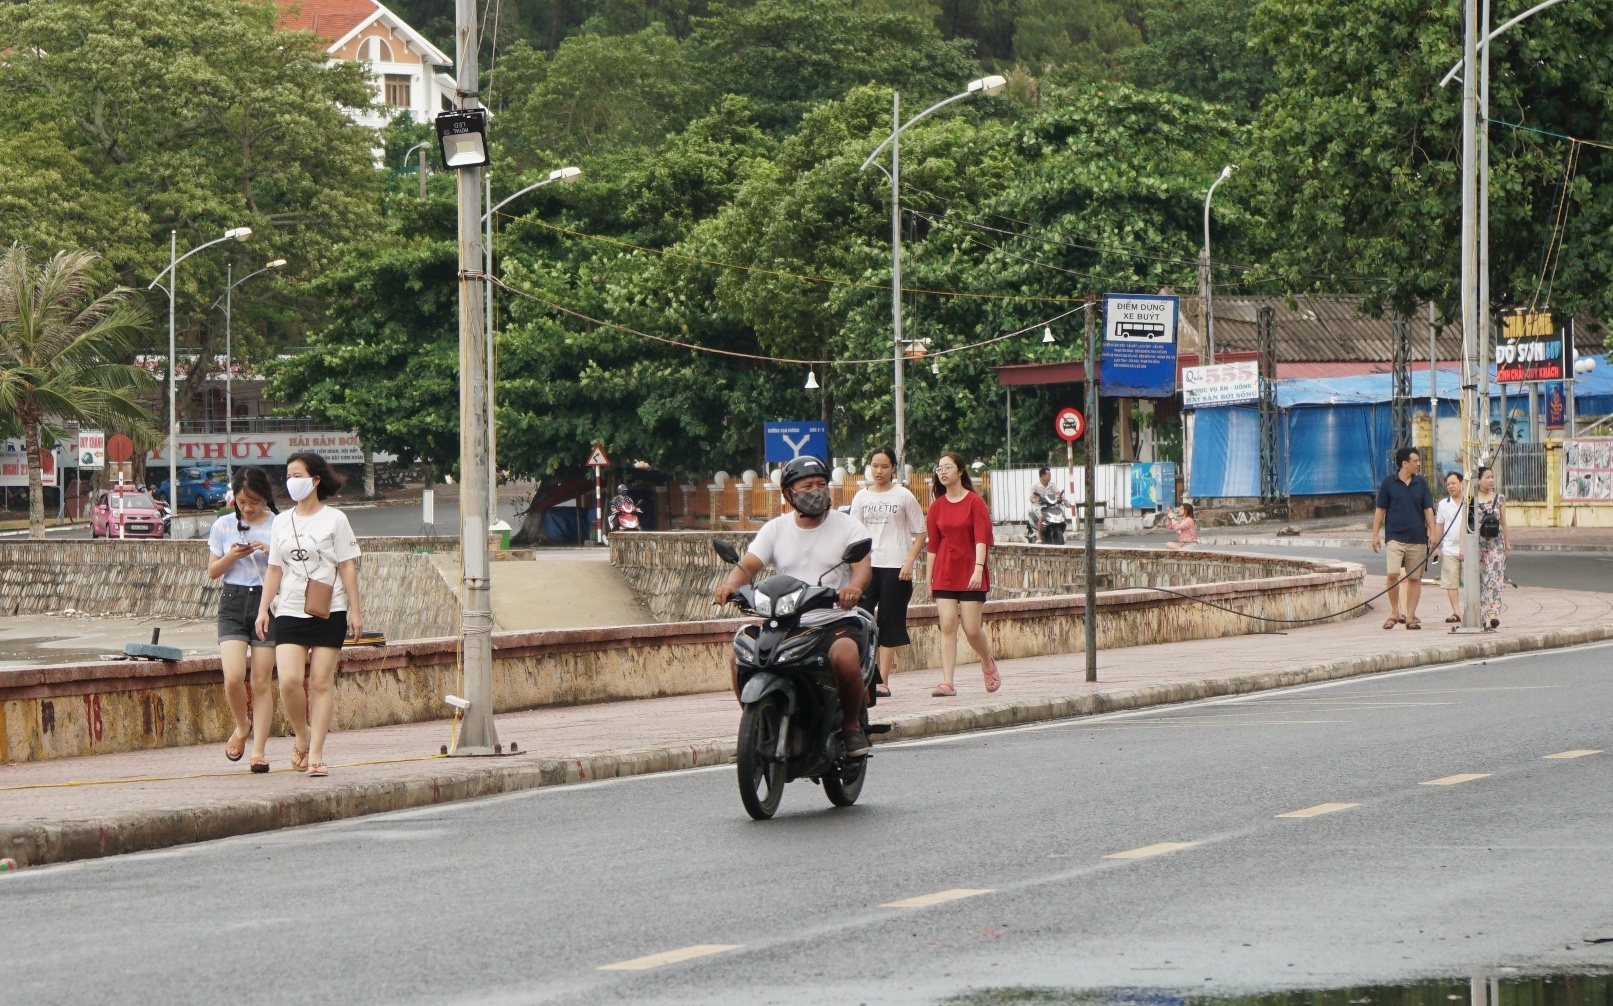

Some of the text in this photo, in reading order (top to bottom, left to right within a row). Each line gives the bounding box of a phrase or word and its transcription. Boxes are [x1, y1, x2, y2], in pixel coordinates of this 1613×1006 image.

[1116, 300, 1166, 311] ĐIỂM DỪNG
[1123, 312, 1160, 320] XE BUÝT
[1517, 341, 1546, 362] SƠN
[1205, 364, 1253, 385] 555
[1539, 361, 1560, 379] KHÁCH
[178, 437, 277, 460] THÚY
[288, 434, 310, 447] HẢI
[312, 434, 336, 447] SẢN
